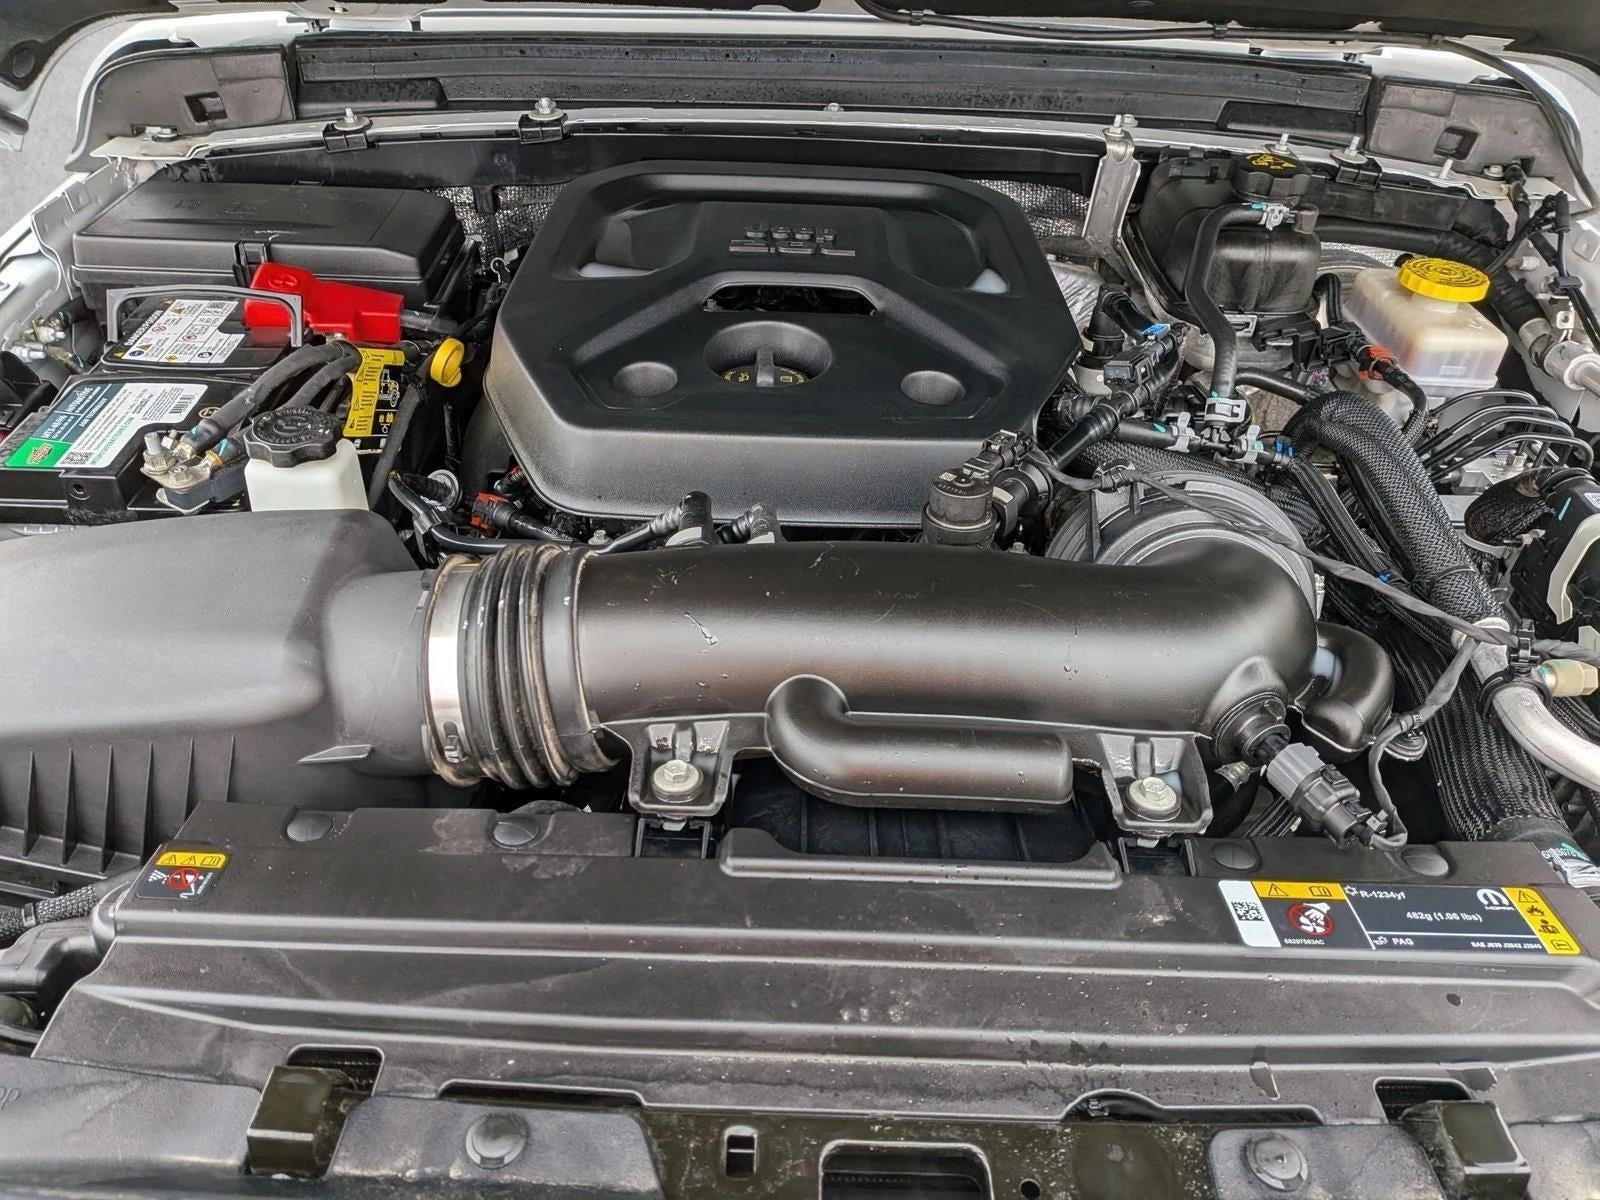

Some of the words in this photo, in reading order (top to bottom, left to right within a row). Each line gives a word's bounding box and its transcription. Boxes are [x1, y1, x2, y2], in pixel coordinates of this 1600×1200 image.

[1359, 889, 1406, 900] R-1234yf
[1406, 911, 1433, 922] 482g
[1433, 911, 1460, 922] (1.06
[1460, 912, 1483, 923] lbs)
[1392, 937, 1414, 946] PAG
